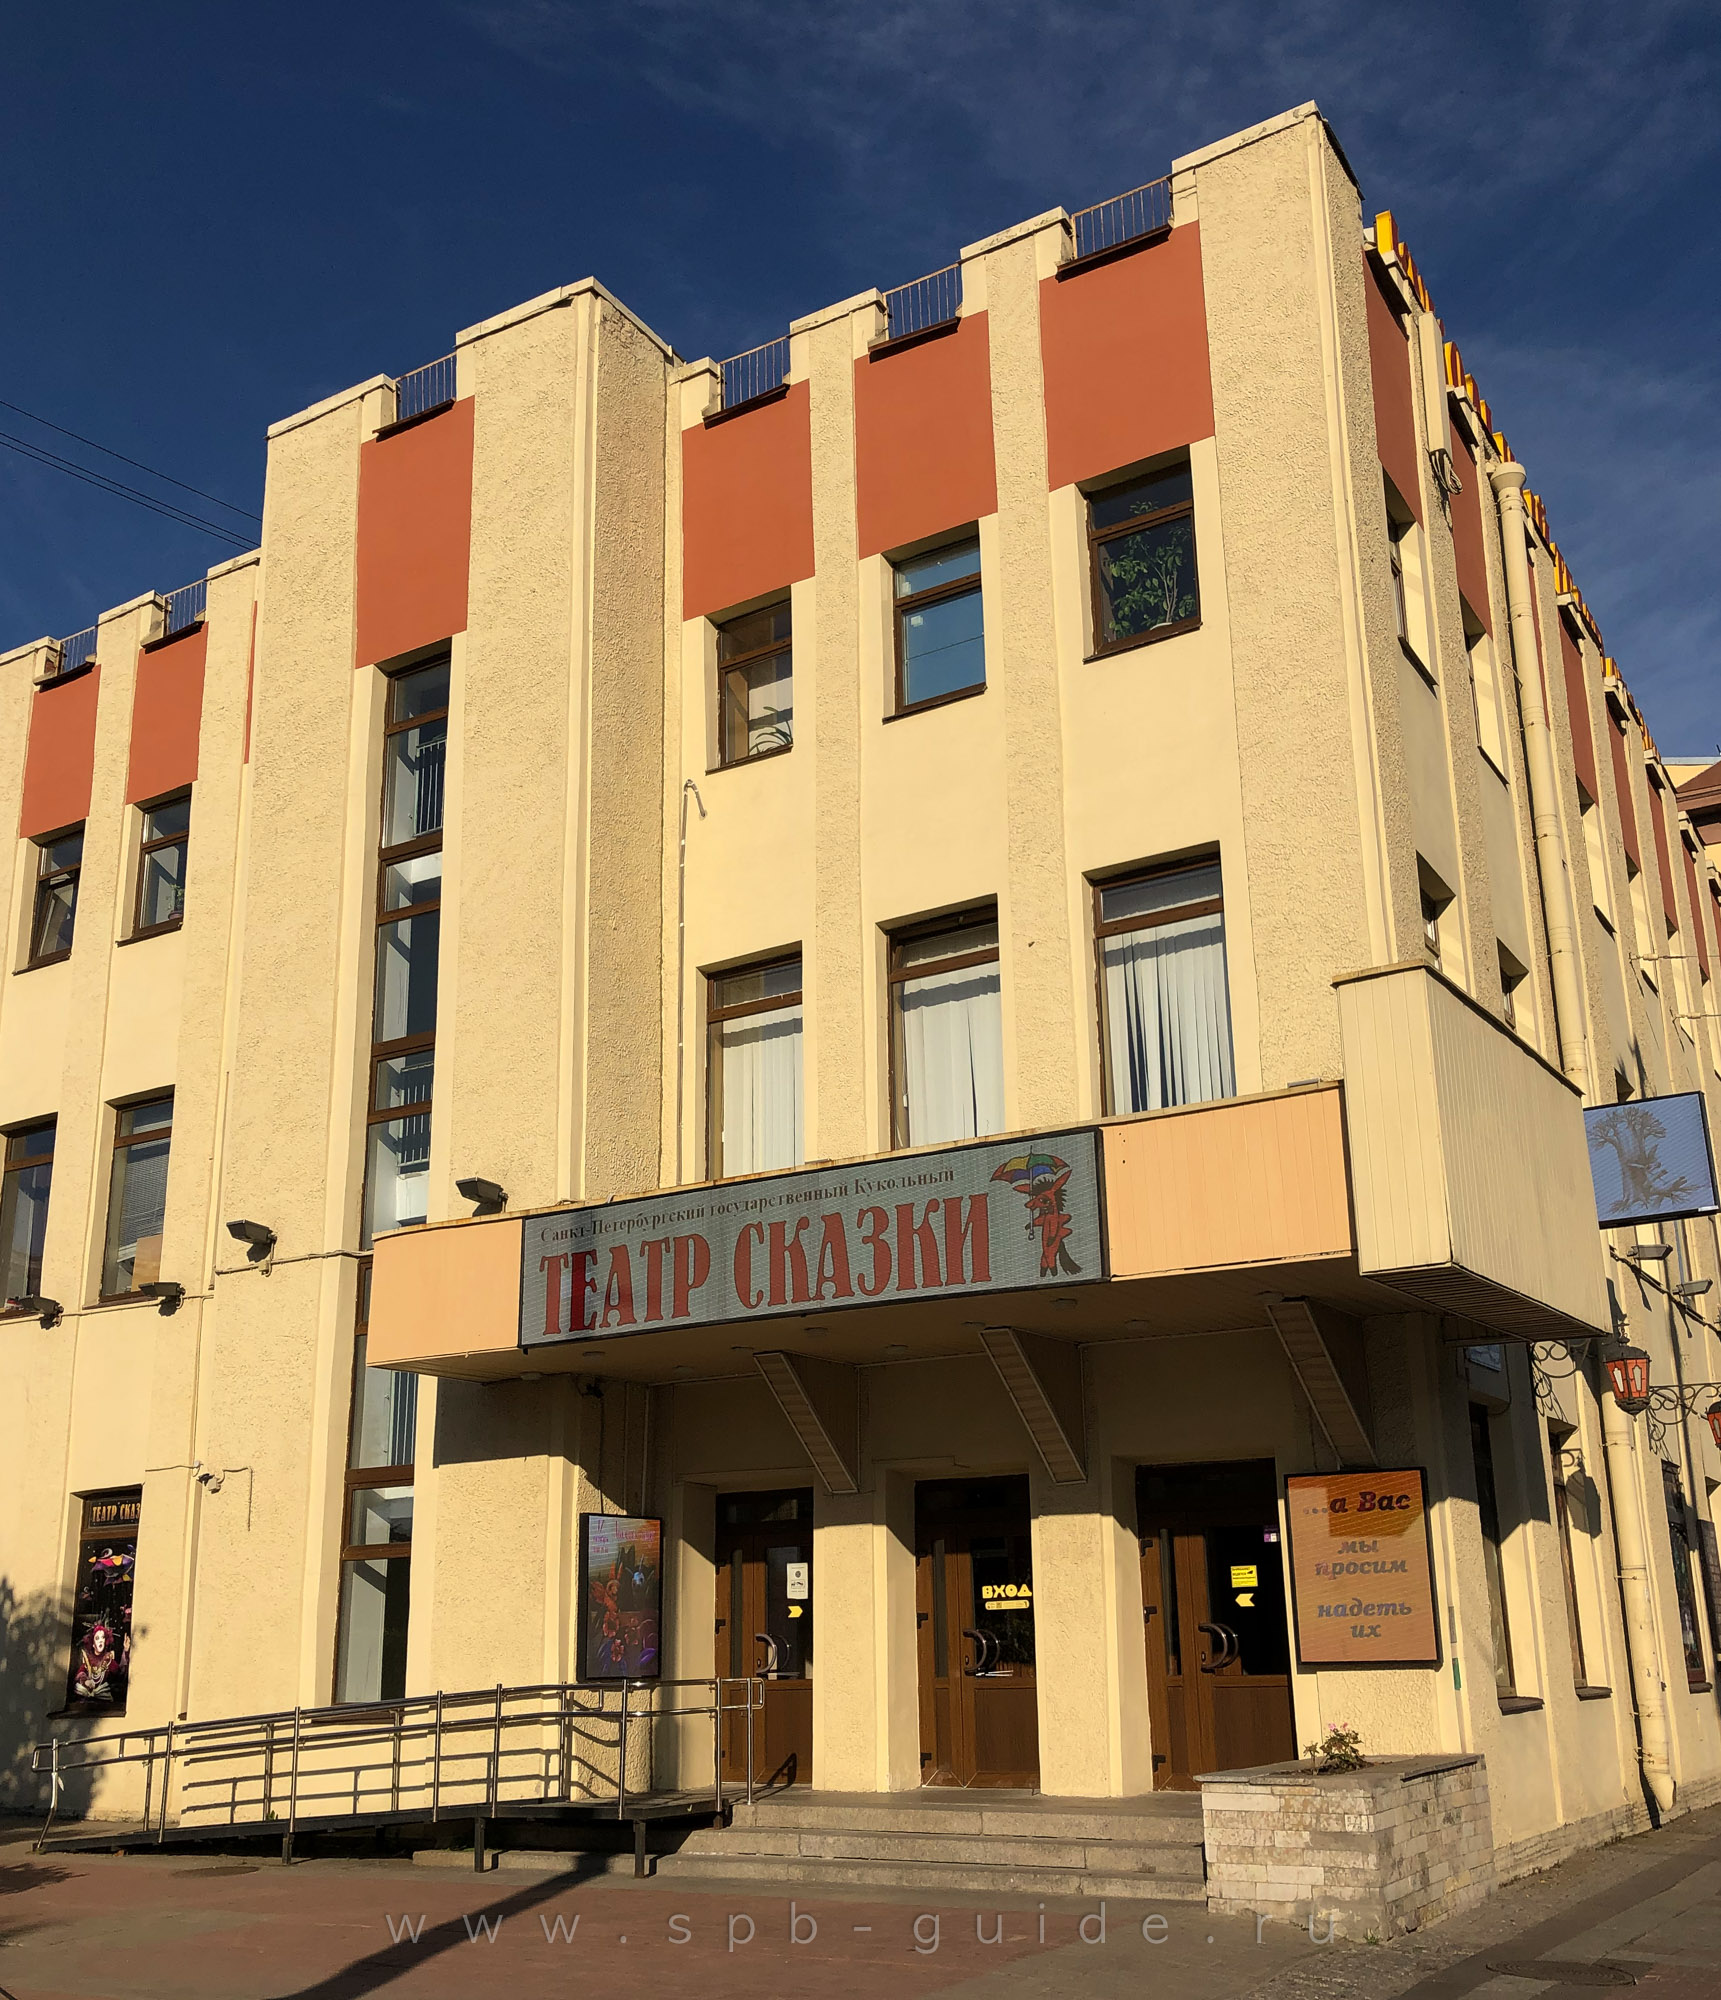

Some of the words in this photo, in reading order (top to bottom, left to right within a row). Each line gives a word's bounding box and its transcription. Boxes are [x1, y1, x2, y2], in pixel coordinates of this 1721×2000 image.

[540, 1203, 705, 1242] Санкт-Петербургский
[710, 1182, 848, 1217] государственный
[854, 1166, 954, 1197] Кукольный
[539, 1232, 711, 1337] ТЕАТР
[733, 1192, 992, 1310] СКАЗКИ
[1357, 1491, 1411, 1512] Вас
[92, 1505, 117, 1522] ТЕАТР
[1337, 1539, 1379, 1554] мы
[1315, 1559, 1408, 1580] просим
[982, 1583, 1032, 1599] ВХОД
[1317, 1598, 1412, 1619] надеть
[1350, 1624, 1382, 1639] их
